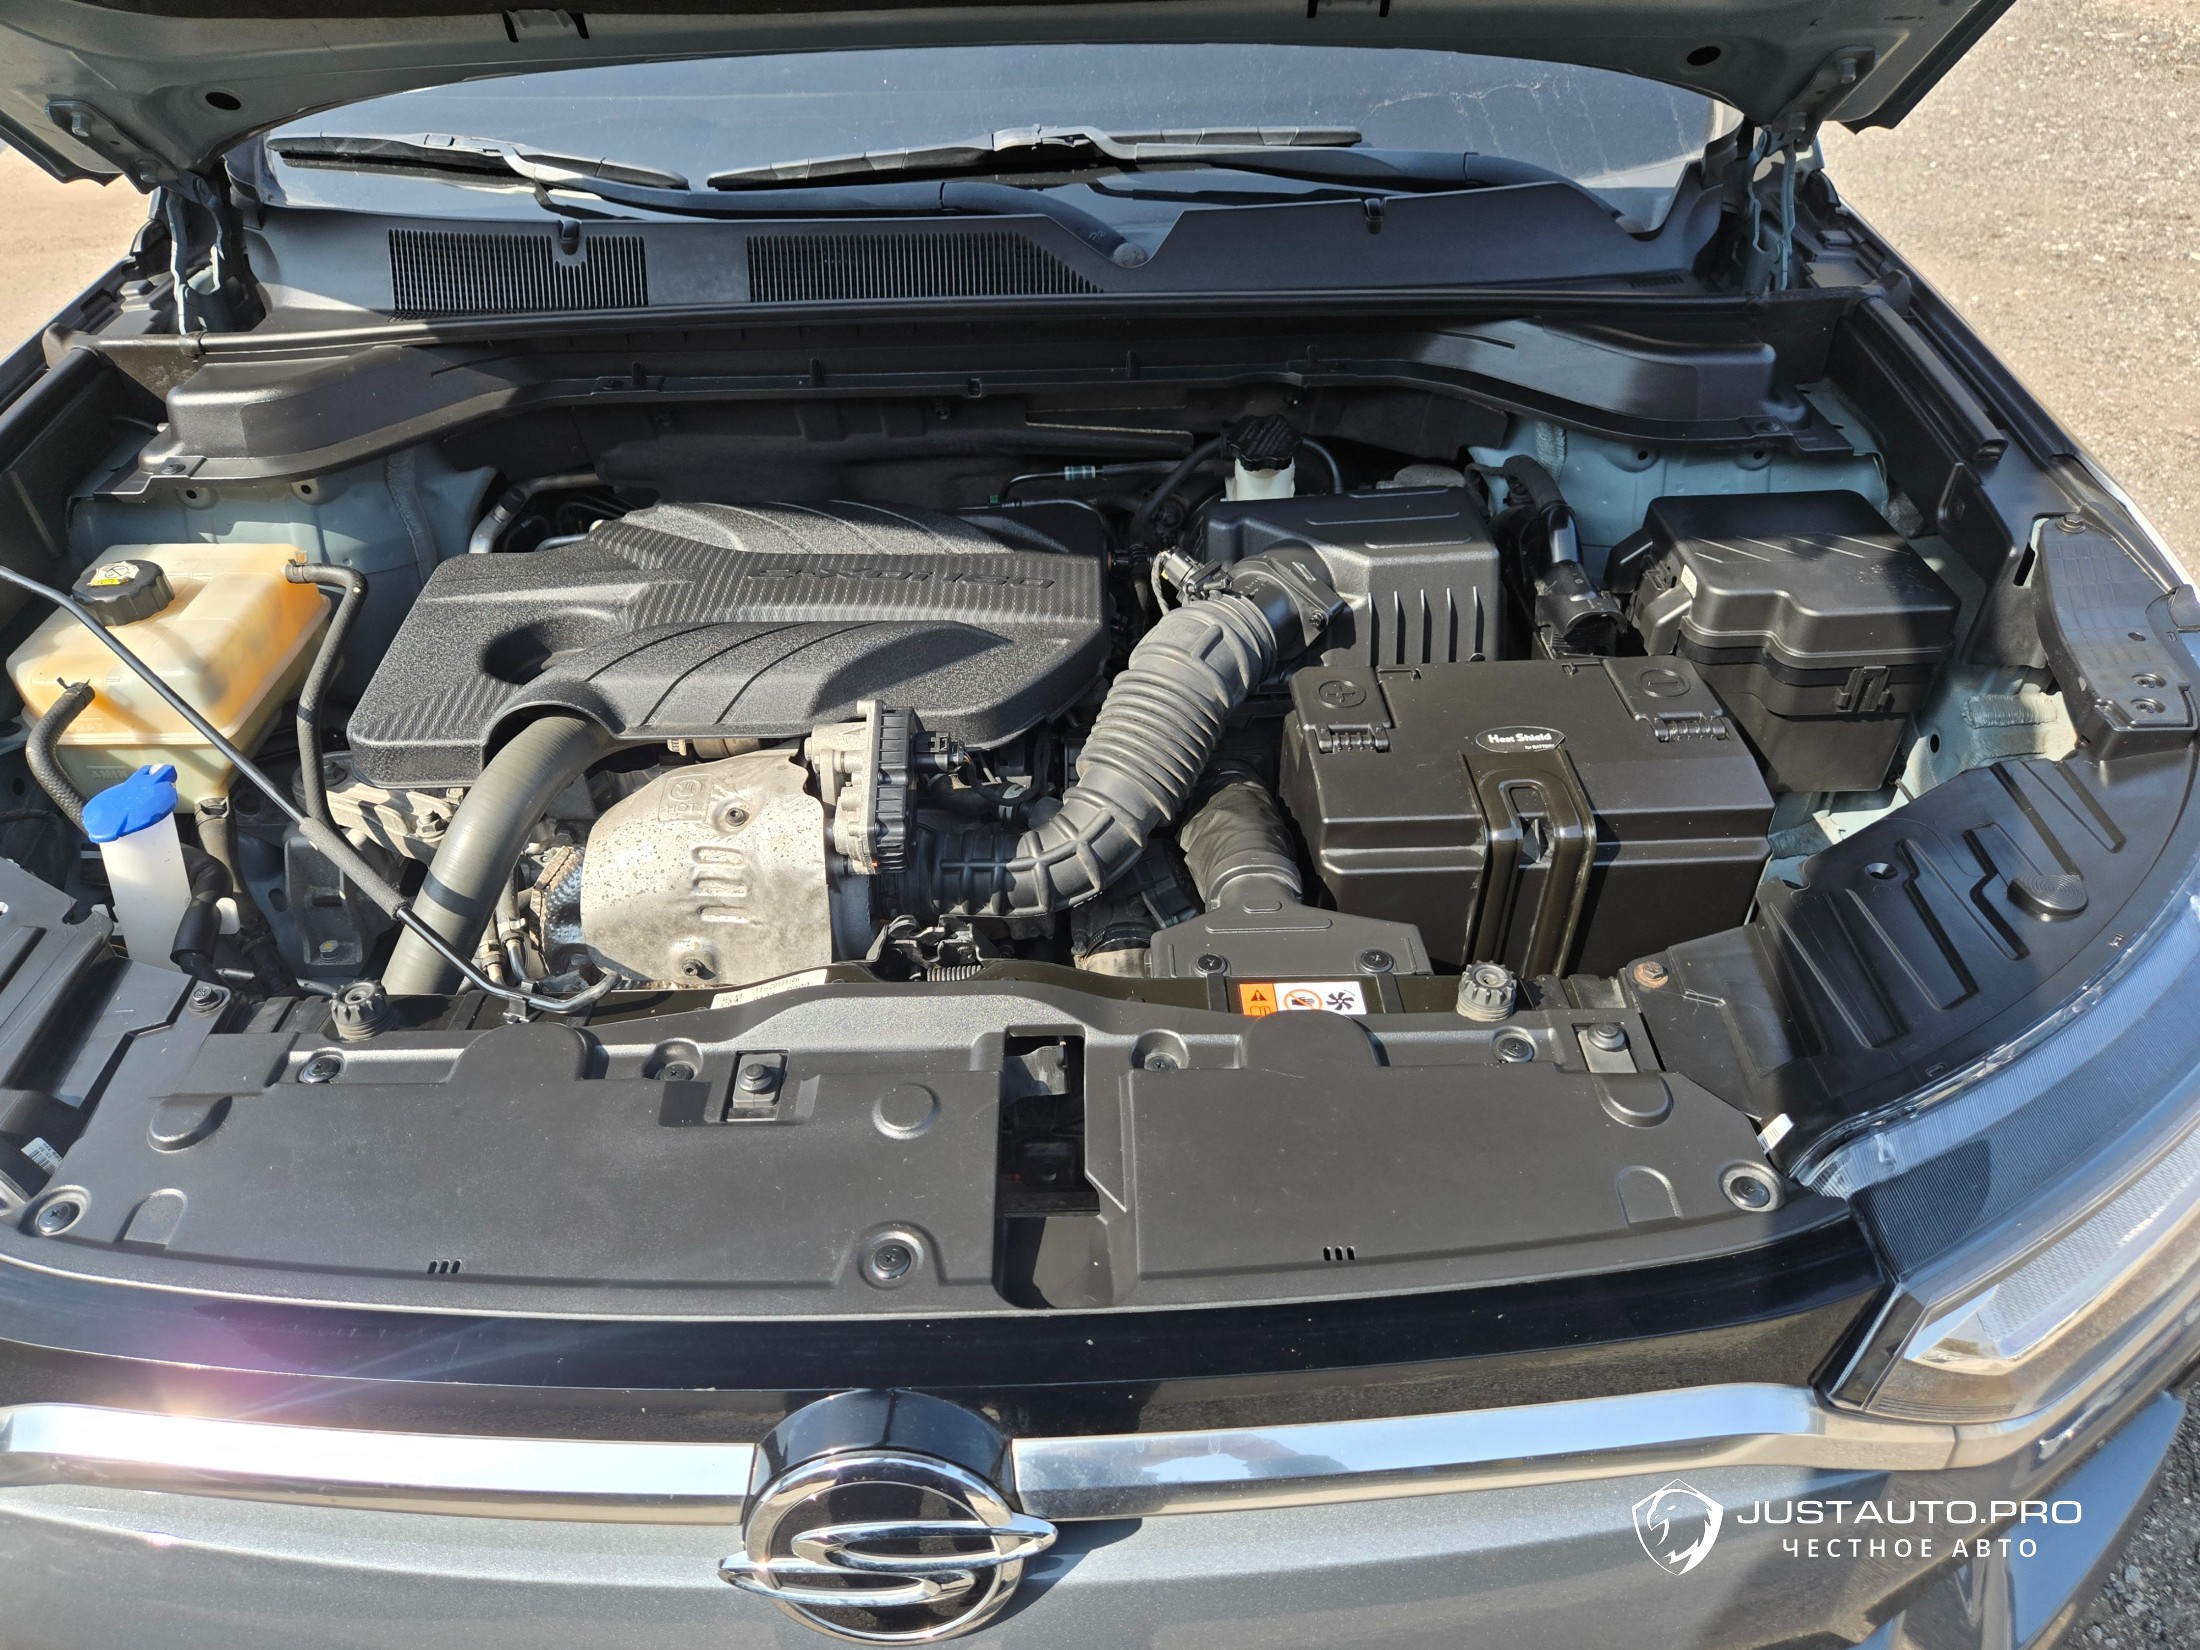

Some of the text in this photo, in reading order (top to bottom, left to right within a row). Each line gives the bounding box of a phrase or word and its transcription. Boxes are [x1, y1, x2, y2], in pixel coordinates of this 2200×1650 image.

[1487, 732, 1552, 744] Heat Shield
[667, 802, 698, 815] HOT
